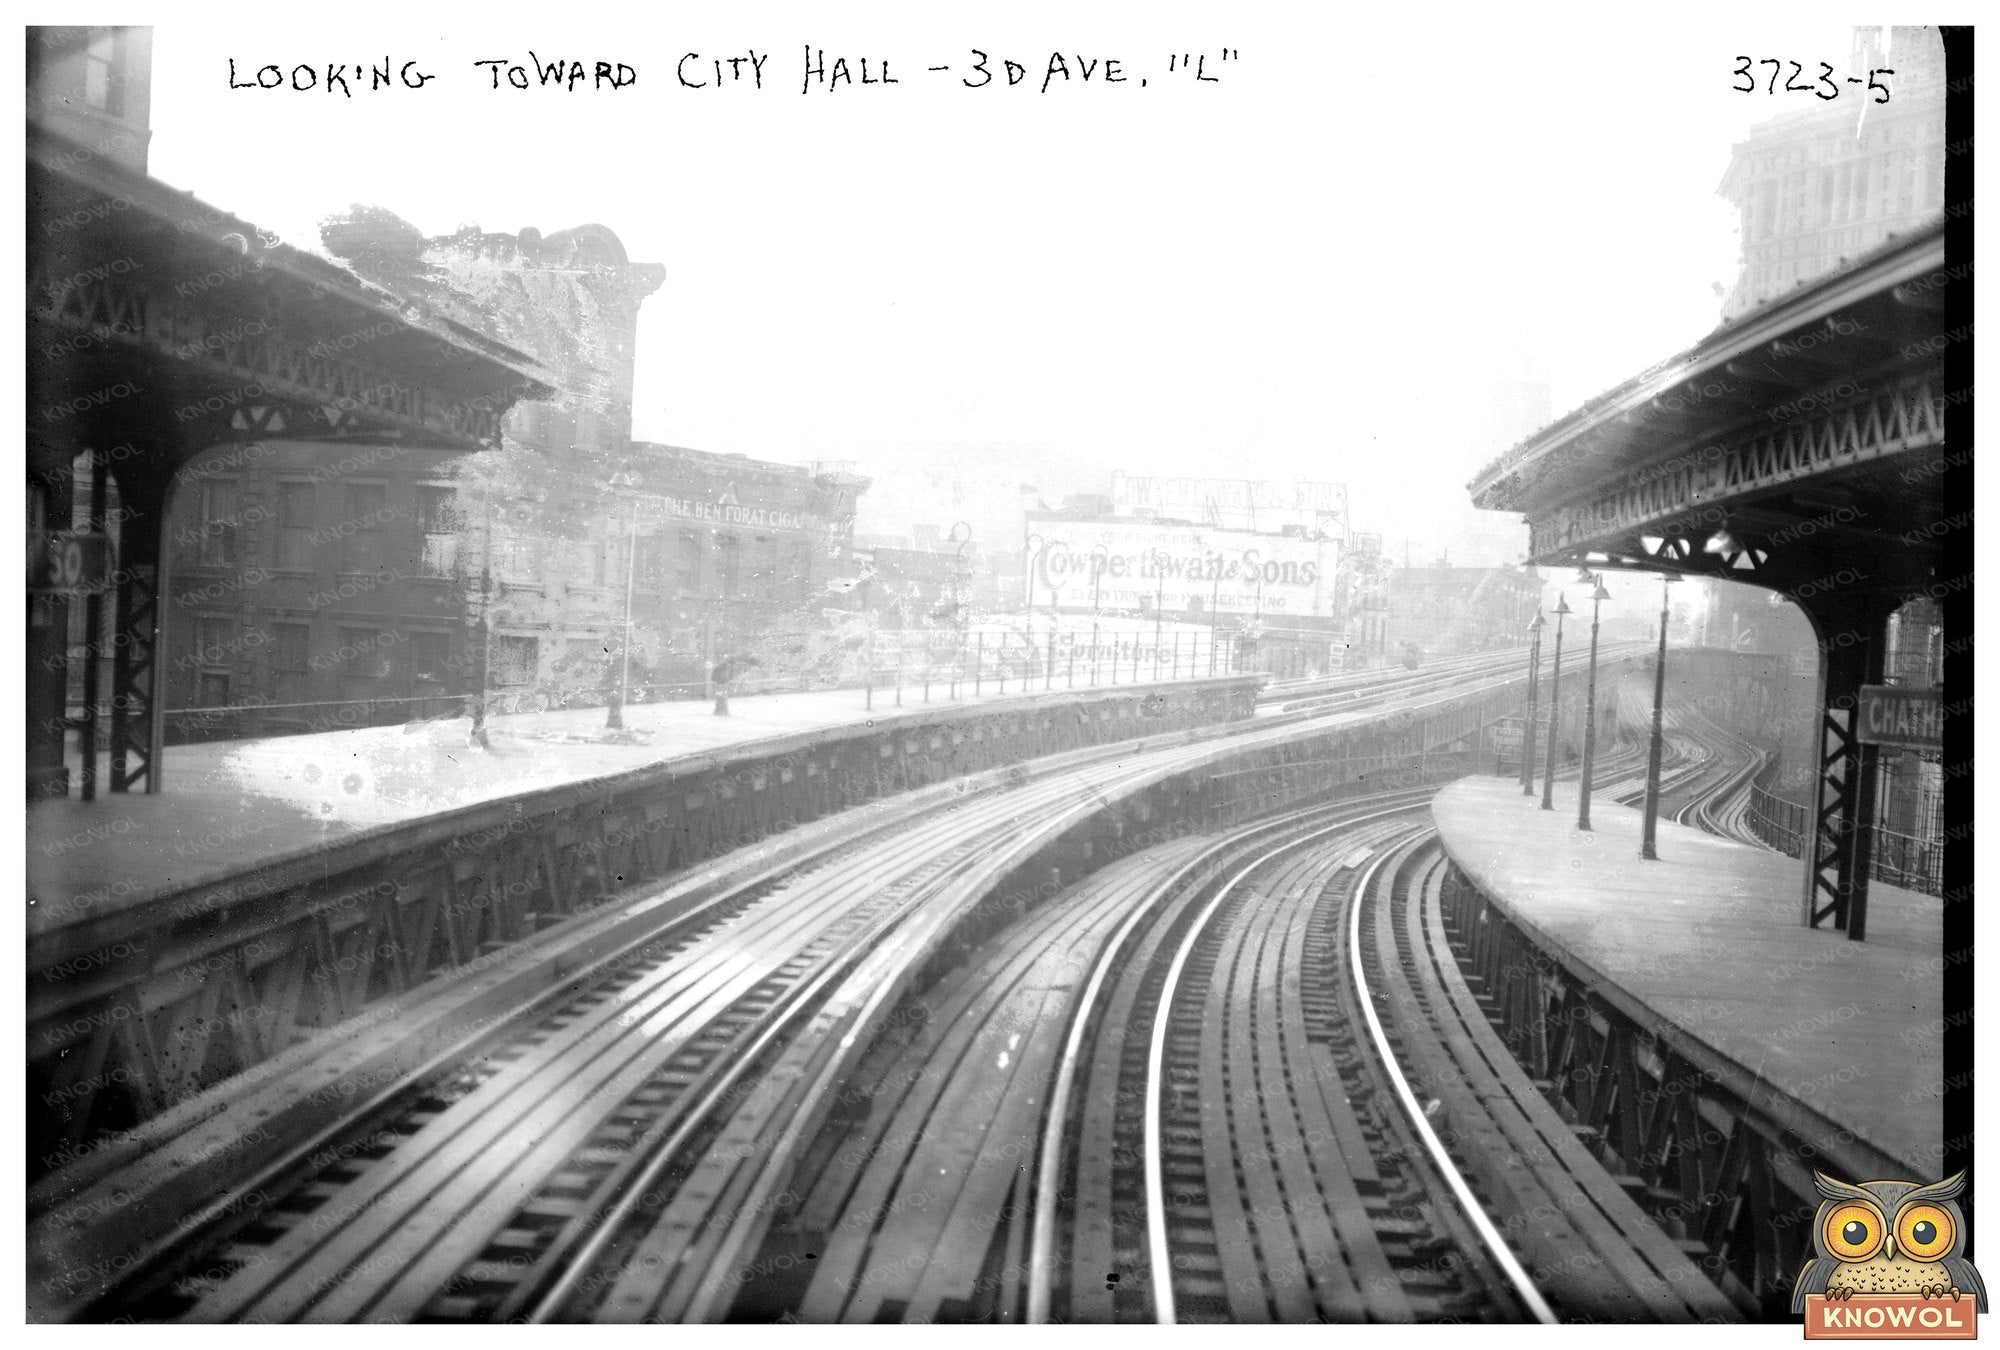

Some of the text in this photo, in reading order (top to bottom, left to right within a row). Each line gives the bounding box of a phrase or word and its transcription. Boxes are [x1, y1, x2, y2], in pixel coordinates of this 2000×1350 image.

[229, 55, 436, 98] LOOKING
[474, 50, 637, 92] TOWARD
[677, 49, 768, 89] CITY
[802, 44, 899, 95] HALL
[1041, 51, 1147, 94] AVE.
[1733, 55, 1895, 105] 3723-5
[695, 501, 721, 520] BEN
[769, 510, 803, 529] CIGA
[1242, 548, 1318, 586] Sons
